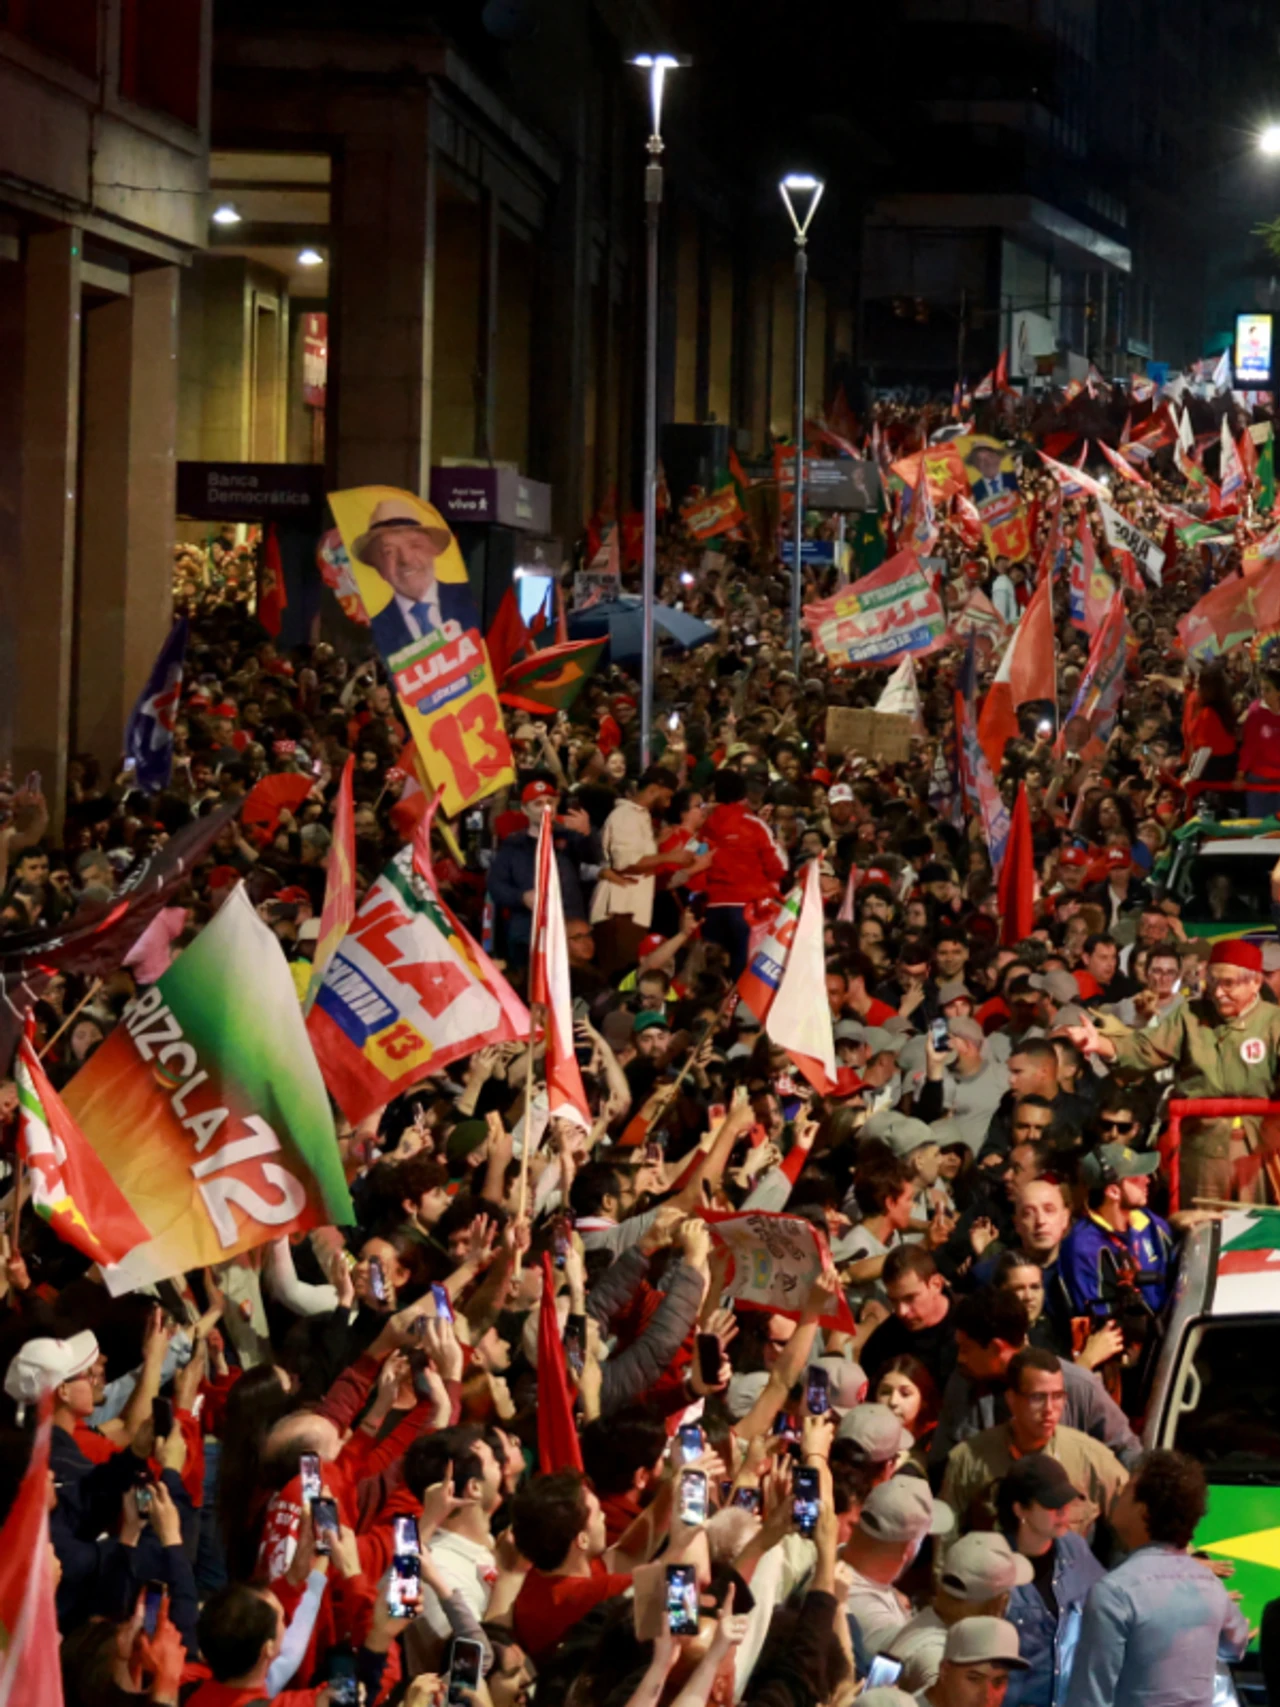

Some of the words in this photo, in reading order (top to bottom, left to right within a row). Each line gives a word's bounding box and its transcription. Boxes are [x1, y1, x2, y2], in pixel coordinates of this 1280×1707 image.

[207, 472, 259, 487] Banca
[207, 489, 310, 505] Democrática
[448, 499, 477, 510] vivo
[398, 636, 479, 696] LULA
[428, 693, 512, 801] 13
[346, 885, 472, 1020] ULA
[376, 1023, 425, 1060] 13
[1246, 1041, 1261, 1059] 13
[127, 986, 229, 1152] RIZOLA
[190, 1114, 306, 1249] 12
